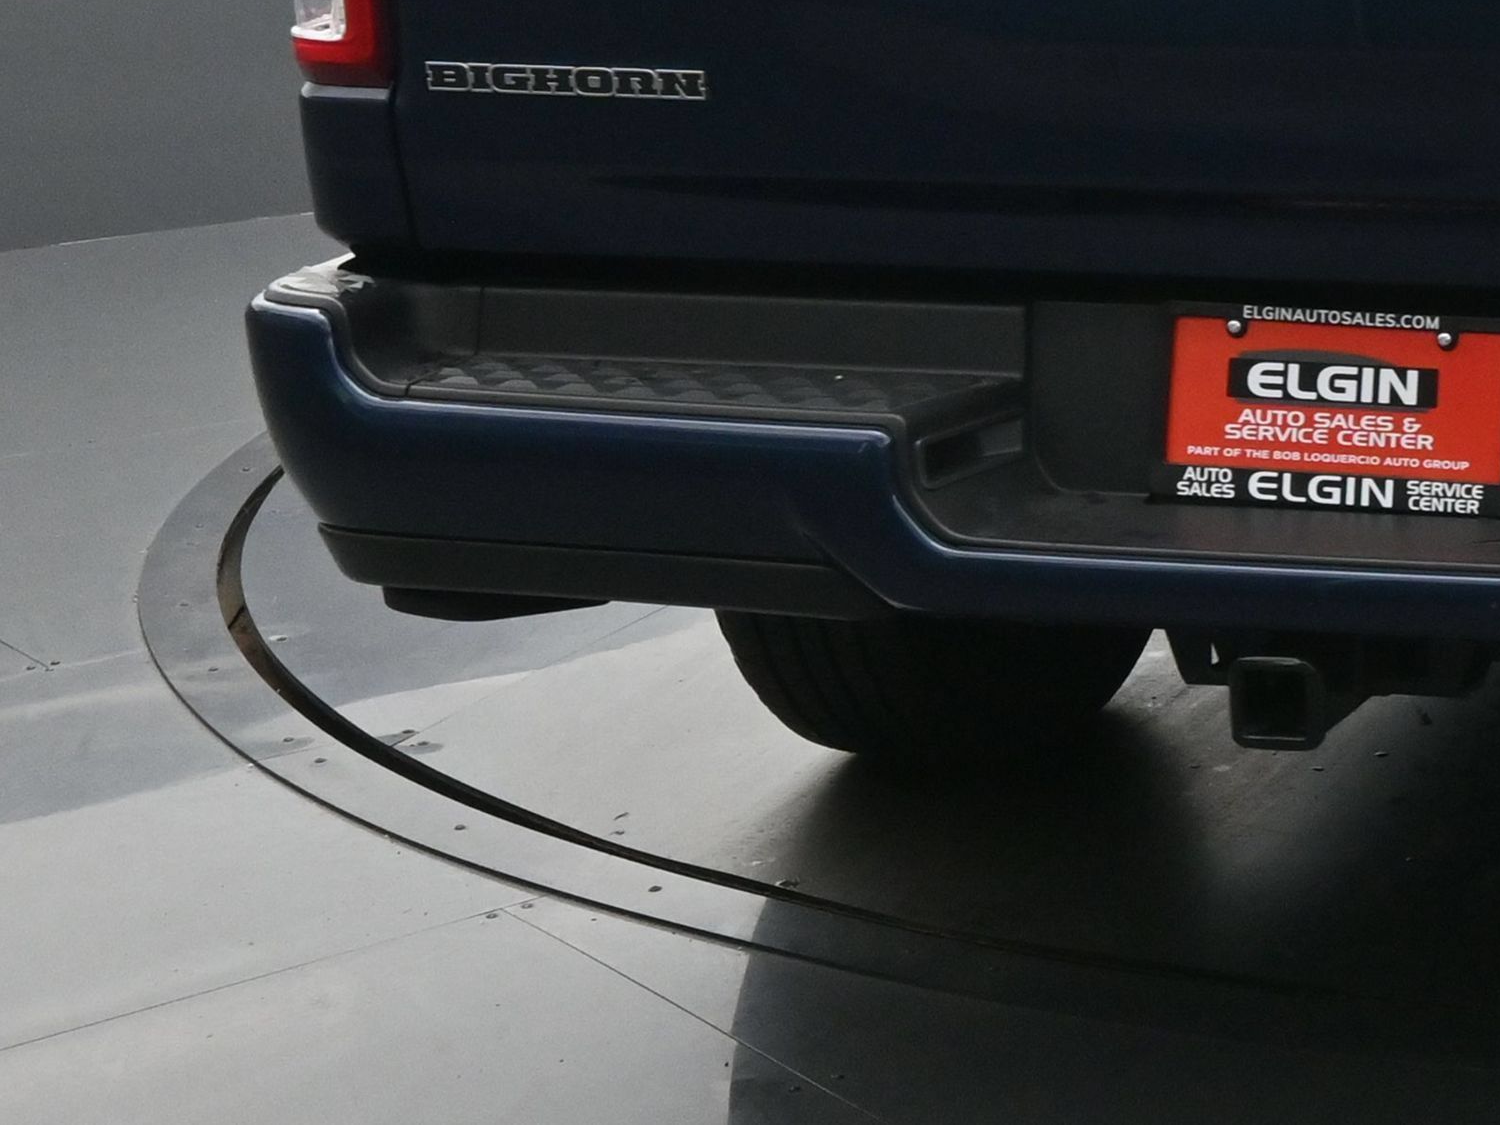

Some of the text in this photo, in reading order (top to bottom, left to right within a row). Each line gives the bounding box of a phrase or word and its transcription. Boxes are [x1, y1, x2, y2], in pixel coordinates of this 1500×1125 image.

[424, 60, 706, 100] BIGHORN
[1242, 304, 1440, 330] ELGINAUTOSALES.COM
[1246, 361, 1419, 406] ELGIN
[1237, 408, 1422, 434] AUTO SALES &
[1224, 423, 1434, 451] SERVICE CENTER
[1186, 445, 1470, 471] PART OF THE BOB LOQUERCIO AUTO GROUP
[1182, 466, 1233, 483] AUTO
[1176, 481, 1235, 499] SALES
[1247, 470, 1395, 509] ELGIN
[1406, 480, 1484, 500] SERVICE
[1408, 496, 1480, 515] CENTER
